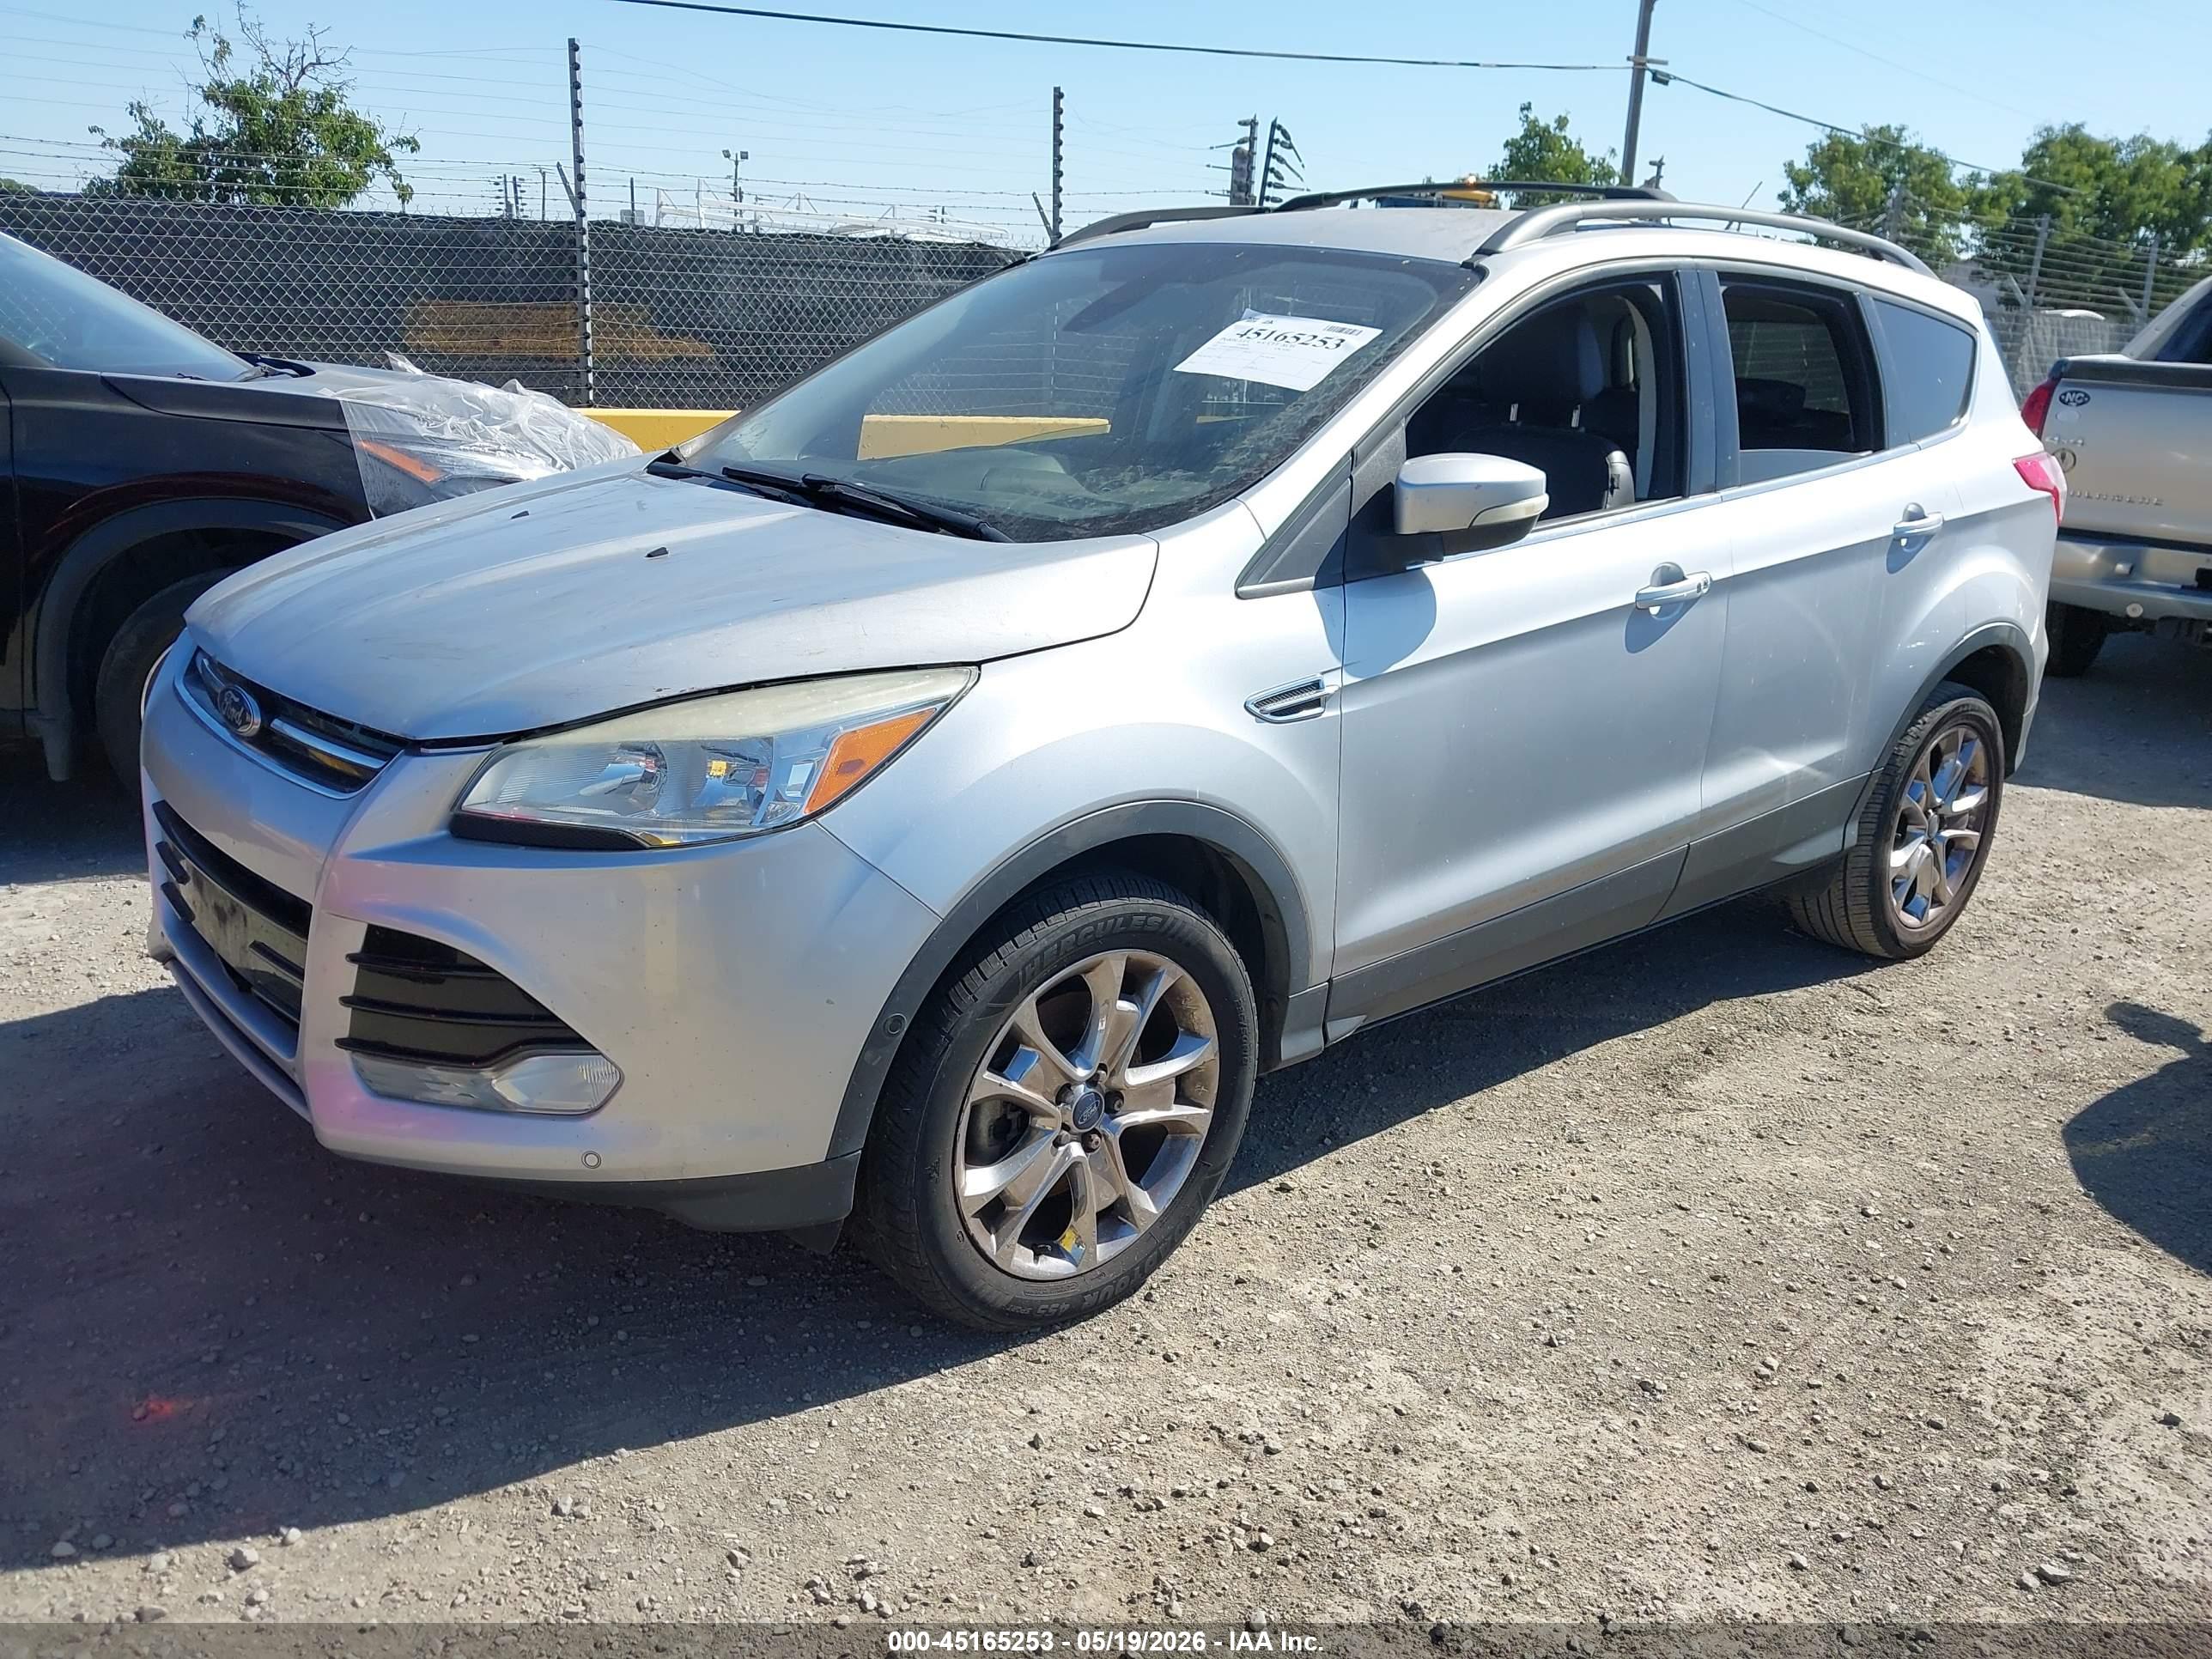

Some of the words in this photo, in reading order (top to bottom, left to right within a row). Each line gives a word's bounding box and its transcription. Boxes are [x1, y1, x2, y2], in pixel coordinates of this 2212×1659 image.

[1237, 327, 1346, 349] 45165253
[222, 690, 245, 726] Ford
[1024, 915, 1163, 986] HERCULES
[1036, 1303, 1071, 1316] 455
